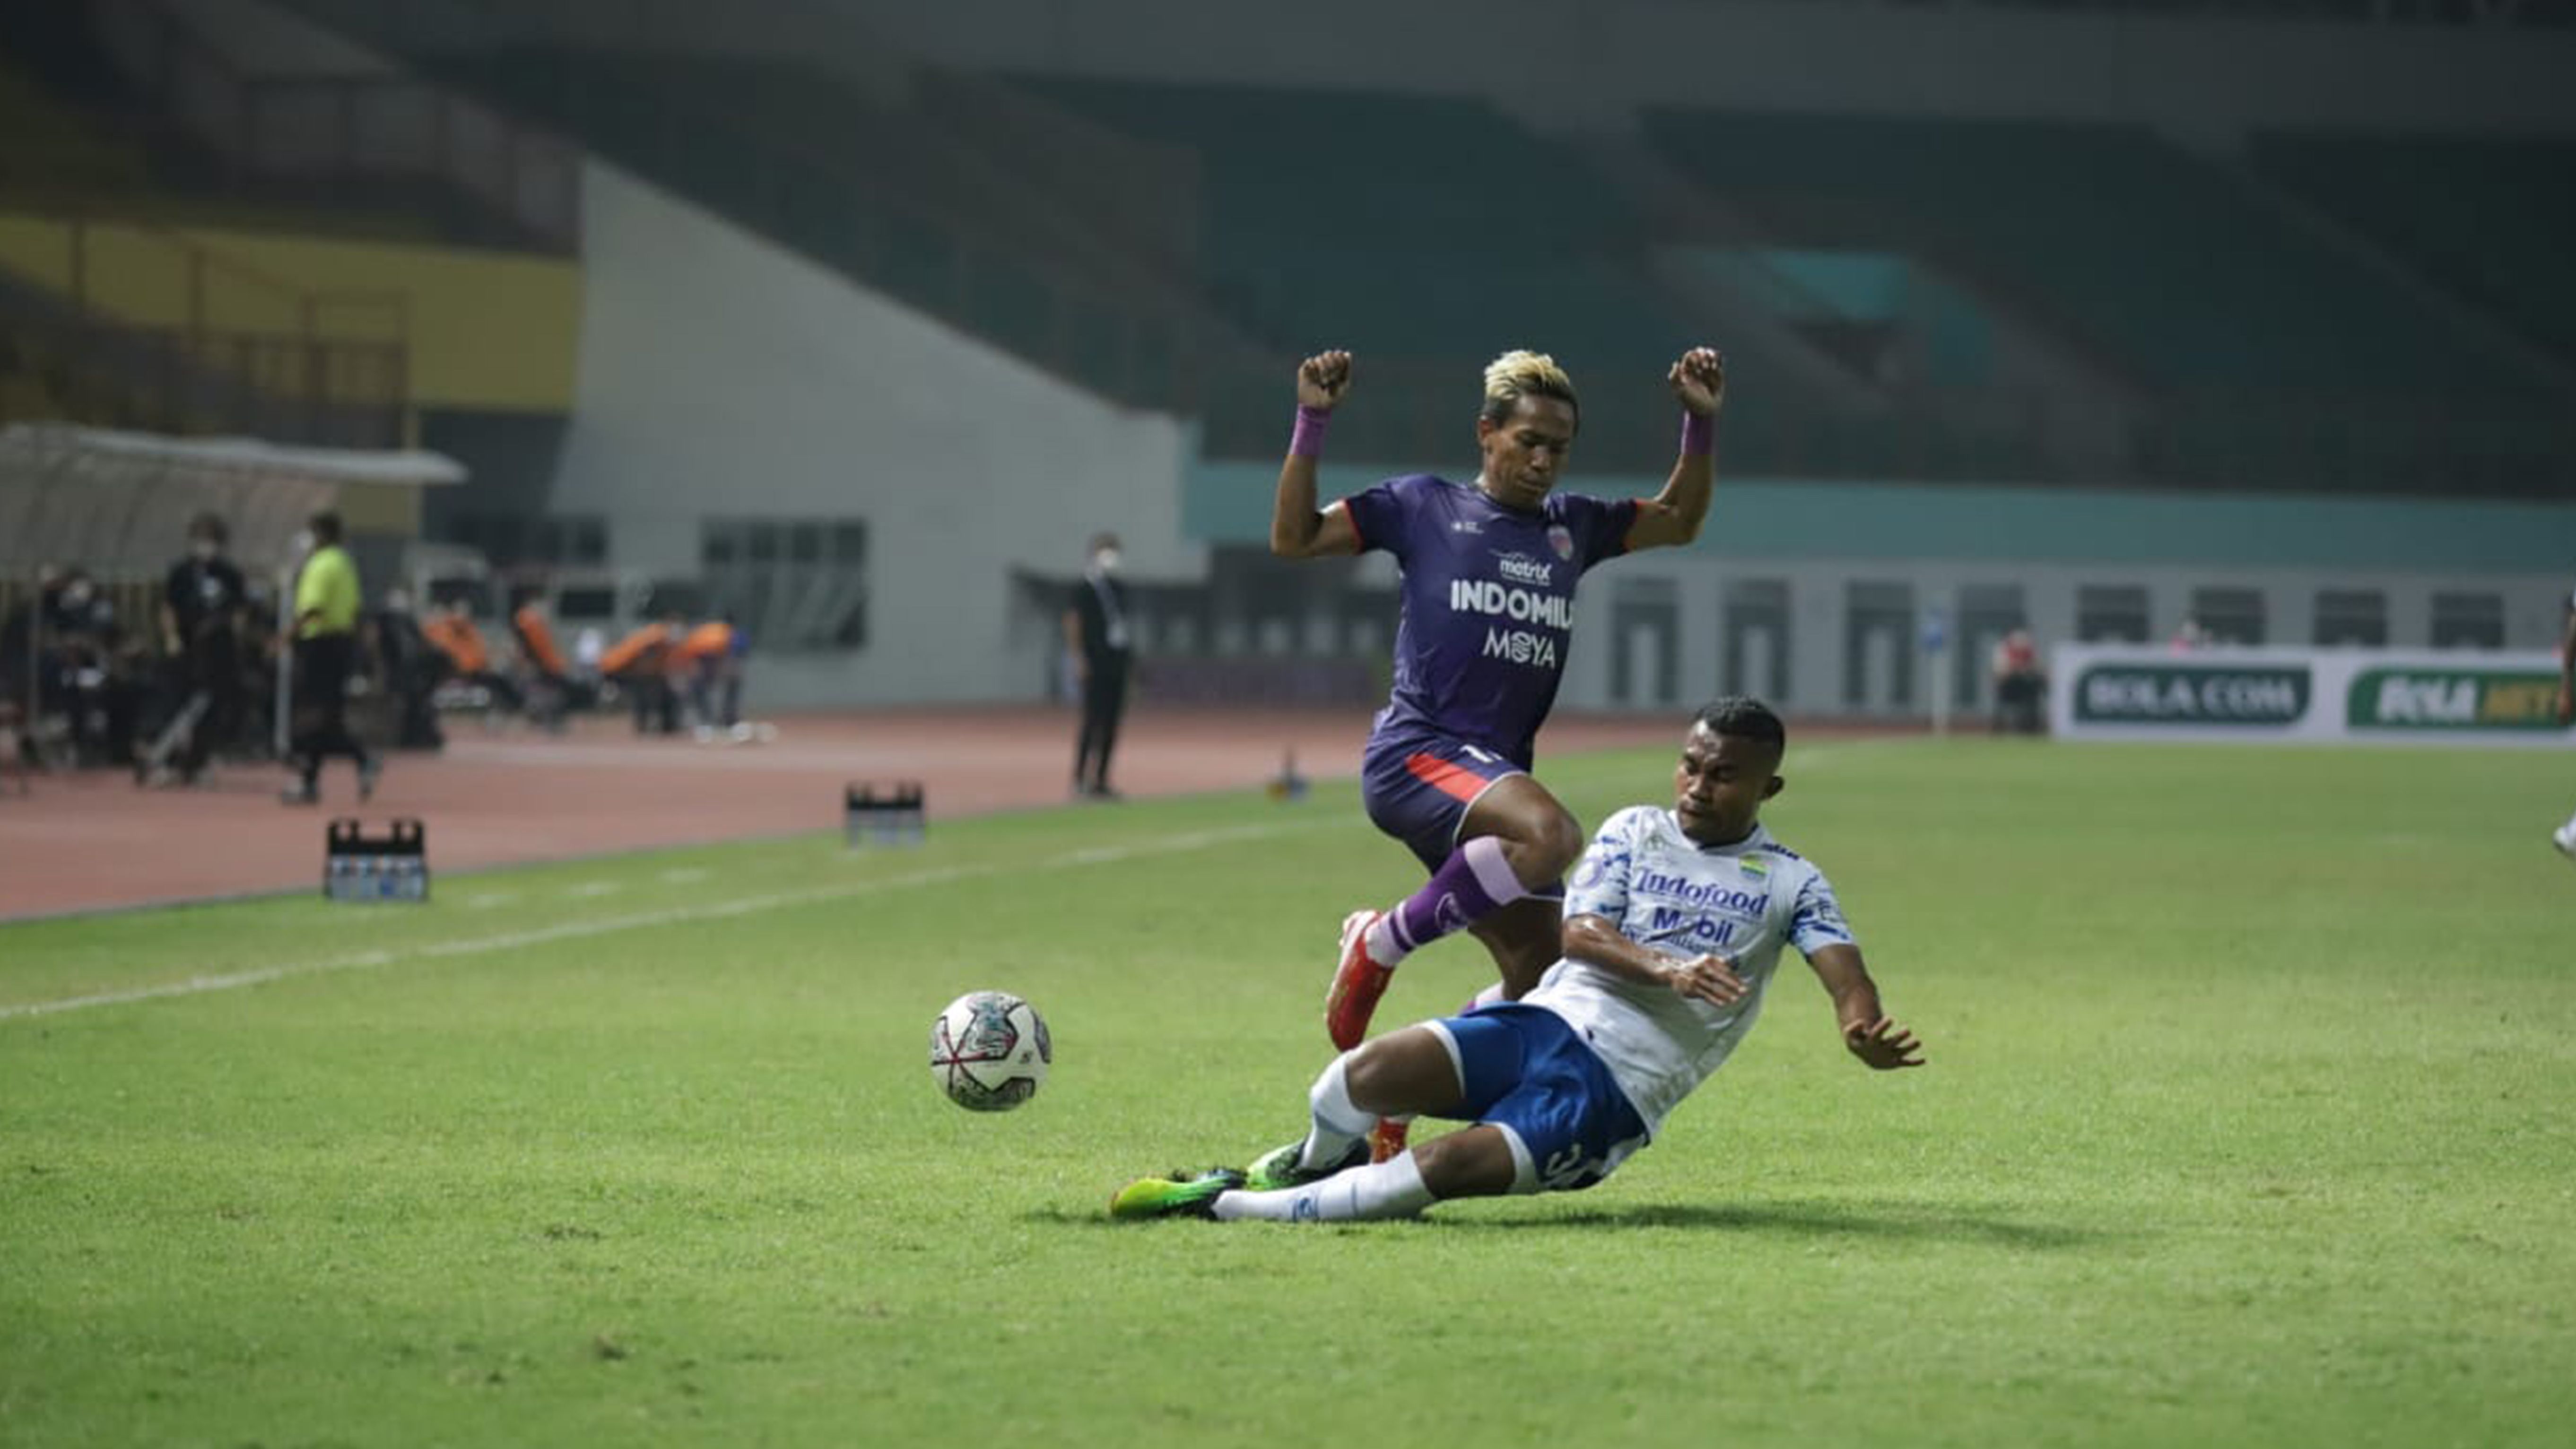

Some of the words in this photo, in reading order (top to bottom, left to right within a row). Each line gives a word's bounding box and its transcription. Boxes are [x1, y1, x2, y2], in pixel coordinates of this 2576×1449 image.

[1451, 579, 1573, 629] INDOMIL
[1482, 626, 1556, 670] MOYA
[1633, 866, 1769, 915] Indofood
[1652, 906, 1733, 945] Mbil
